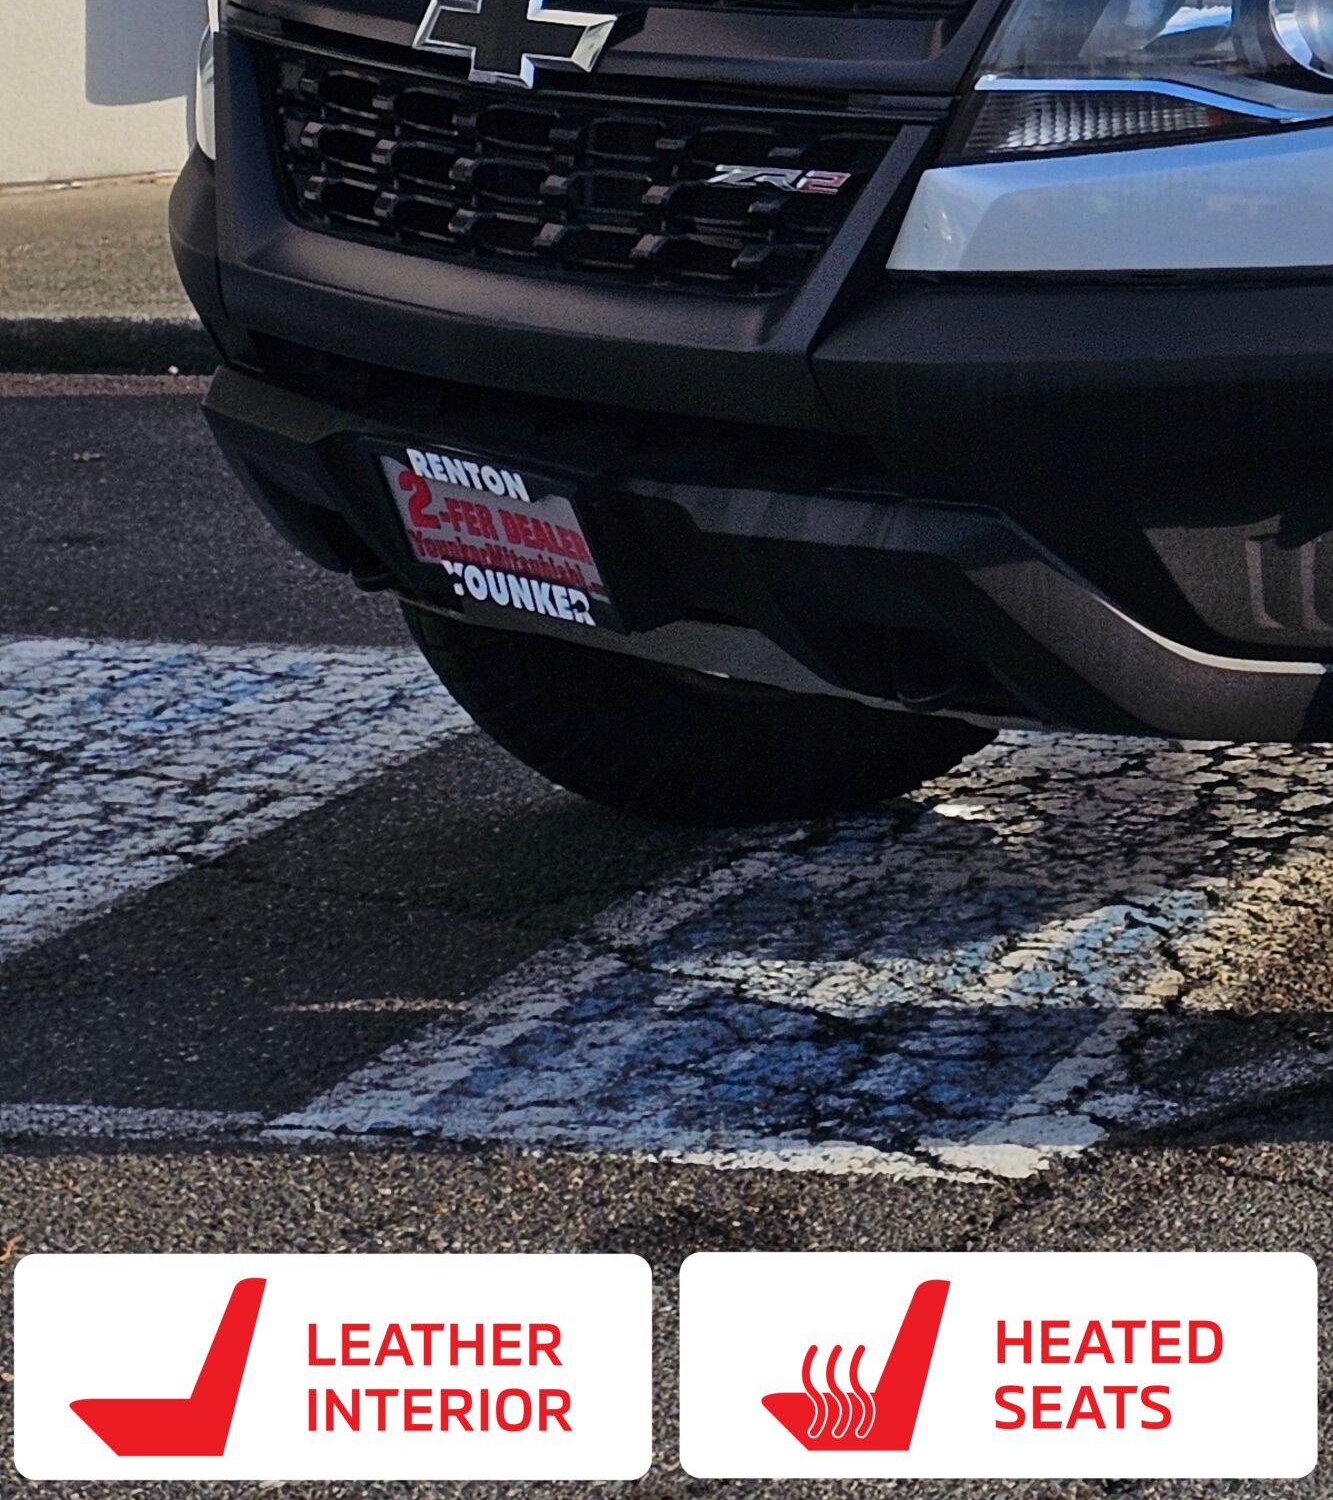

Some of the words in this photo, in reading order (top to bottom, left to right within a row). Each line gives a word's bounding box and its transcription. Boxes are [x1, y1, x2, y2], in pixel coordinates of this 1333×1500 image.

[706, 164, 851, 195] ZR2
[406, 448, 530, 502] RENTON
[498, 508, 593, 564] DEALER
